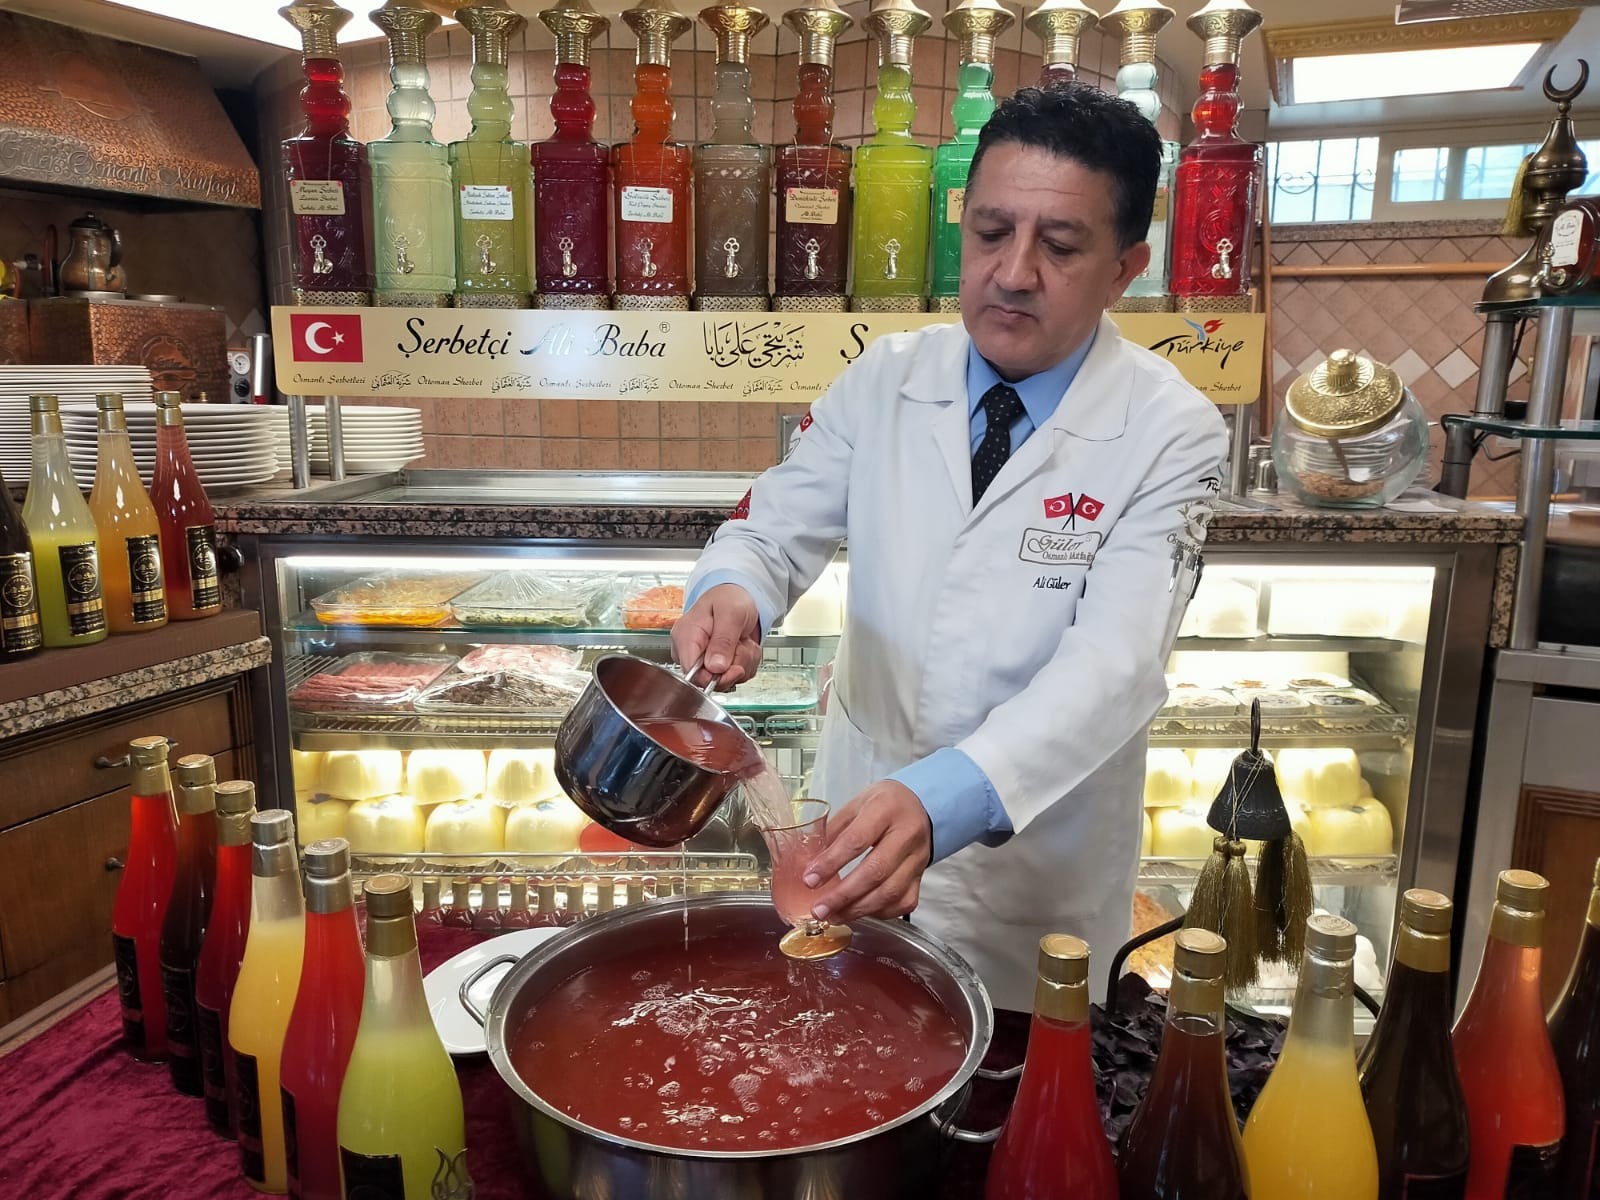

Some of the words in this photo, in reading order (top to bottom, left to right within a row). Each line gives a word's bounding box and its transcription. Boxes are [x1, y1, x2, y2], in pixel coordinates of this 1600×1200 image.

[397, 317, 512, 360] Şerbetçi
[520, 322, 575, 356] Ali
[1148, 332, 1245, 370] Türkiye
[417, 375, 450, 386] Ottoman
[668, 379, 701, 390] Ottoman
[1027, 535, 1084, 553] Güler
[1033, 576, 1045, 588] Ali
[1046, 576, 1072, 590] Güler
